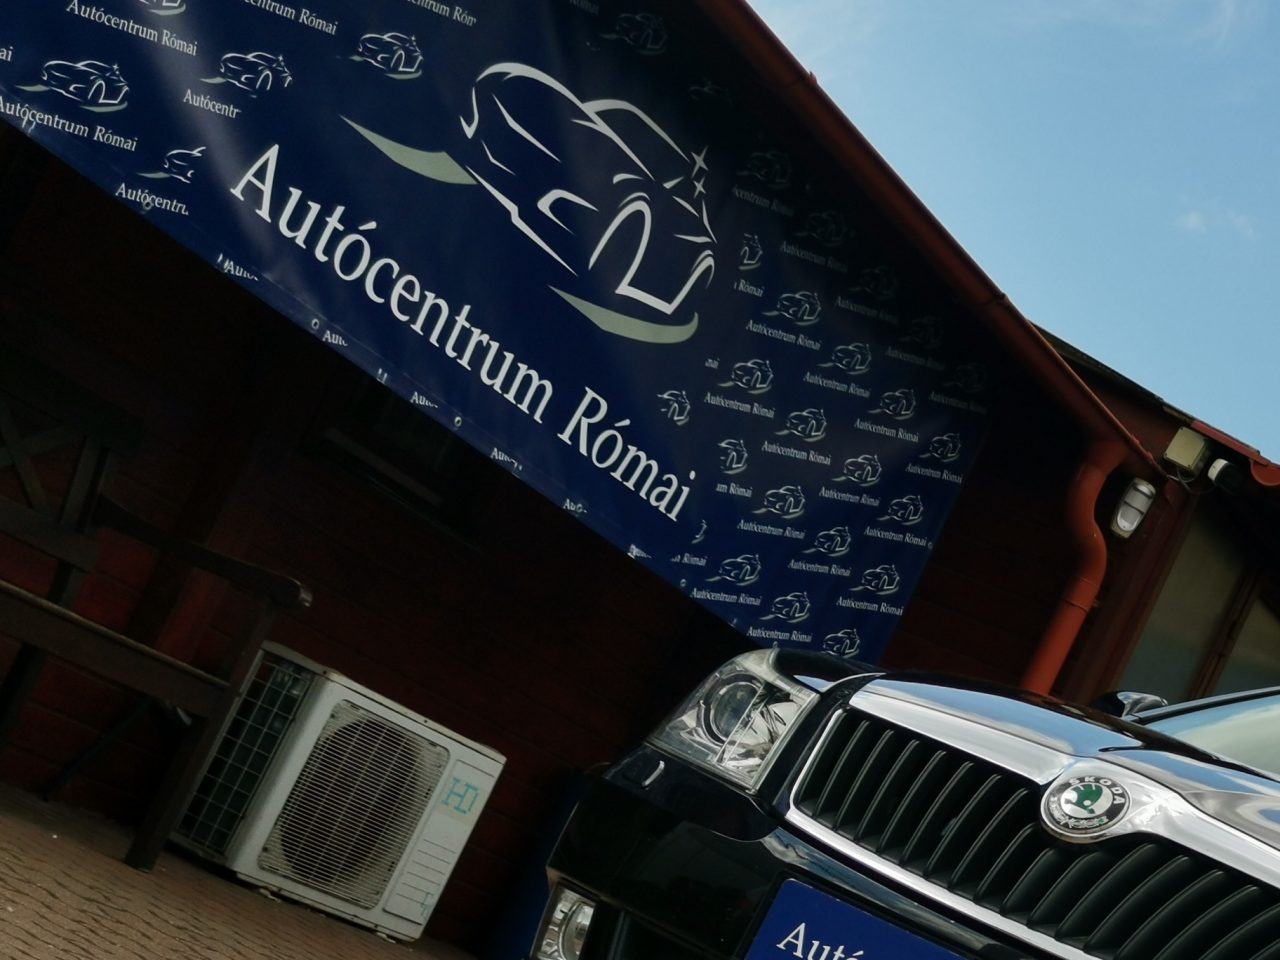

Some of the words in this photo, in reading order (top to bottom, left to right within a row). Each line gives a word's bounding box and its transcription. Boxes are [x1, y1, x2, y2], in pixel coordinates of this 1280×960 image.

[66, 0, 158, 42] Autócentrum
[161, 29, 198, 56] Római
[299, 8, 339, 36] Római
[93, 125, 138, 152] Római
[230, 143, 554, 423] Autócentrum
[557, 386, 696, 522] Római
